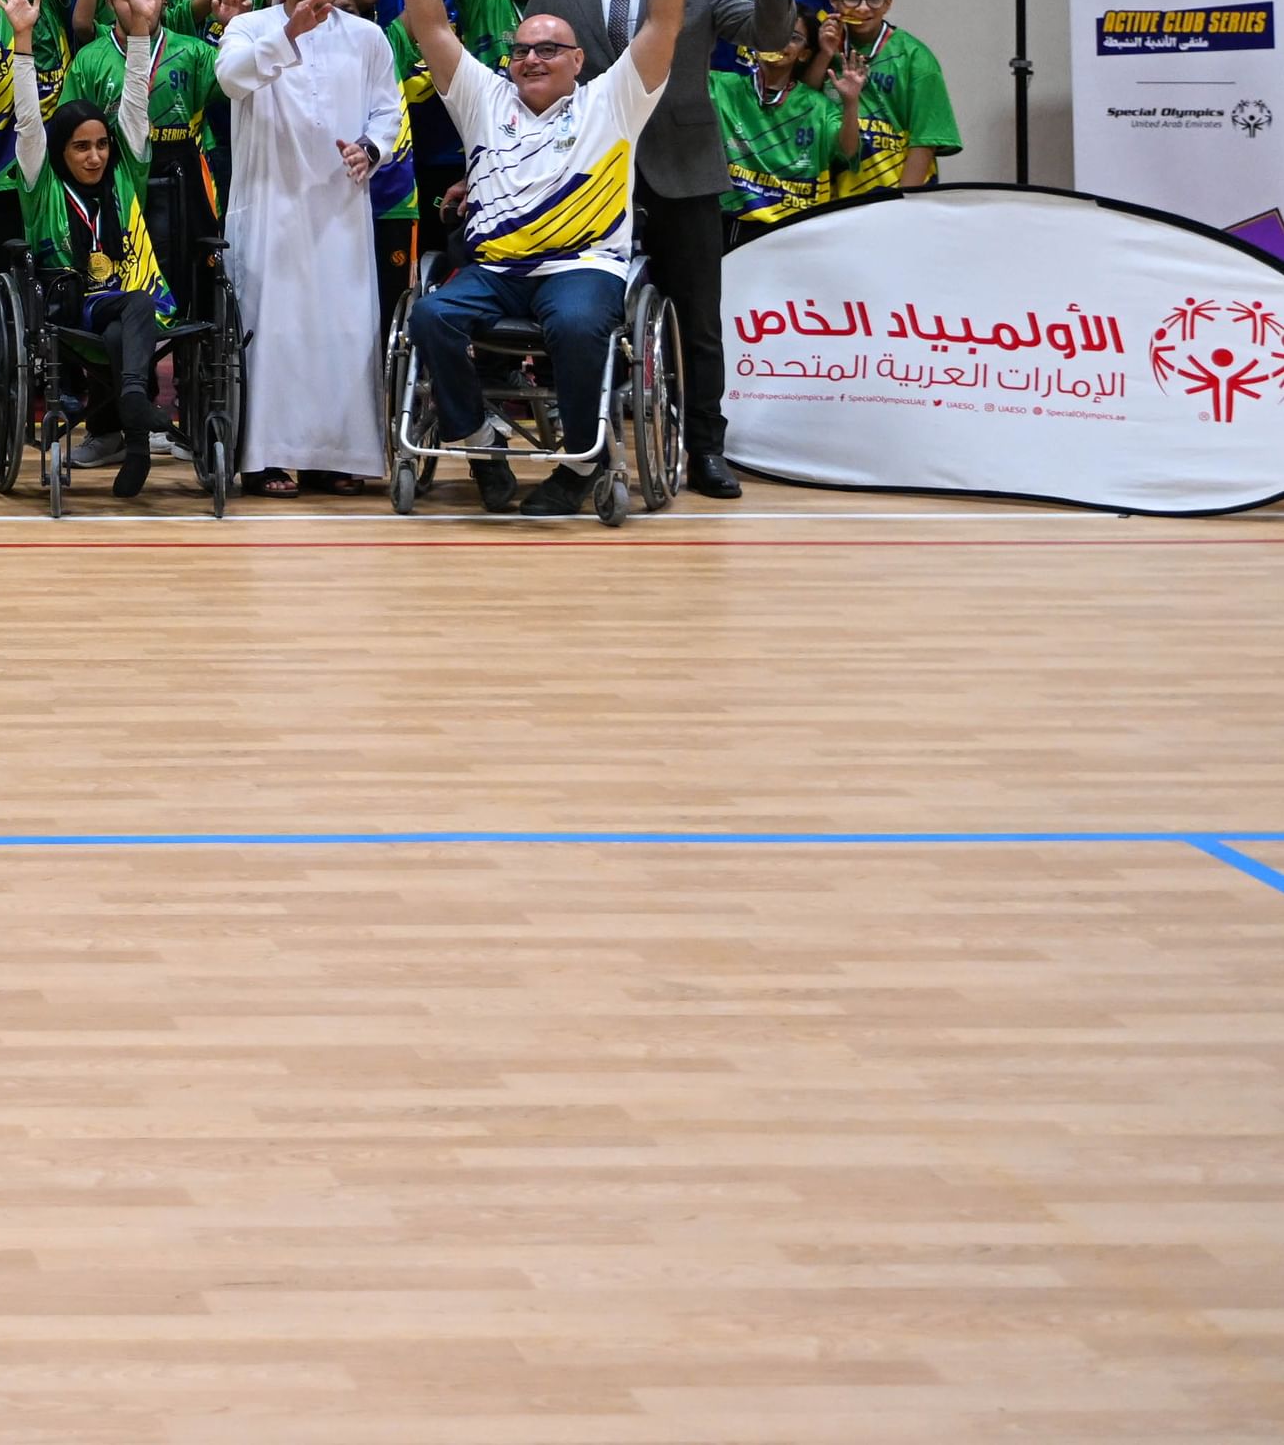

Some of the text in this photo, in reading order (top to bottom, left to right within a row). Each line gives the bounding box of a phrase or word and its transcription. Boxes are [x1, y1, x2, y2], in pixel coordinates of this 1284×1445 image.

[1103, 11, 1268, 33] ACTIVE CLUB SERIES
[1106, 107, 1225, 118] Special Olympics
[733, 299, 1125, 360] الأولمبياد الخاص
[736, 353, 1125, 403] الإمارات العربية المتحدة
[997, 405, 1027, 414] UAESO
